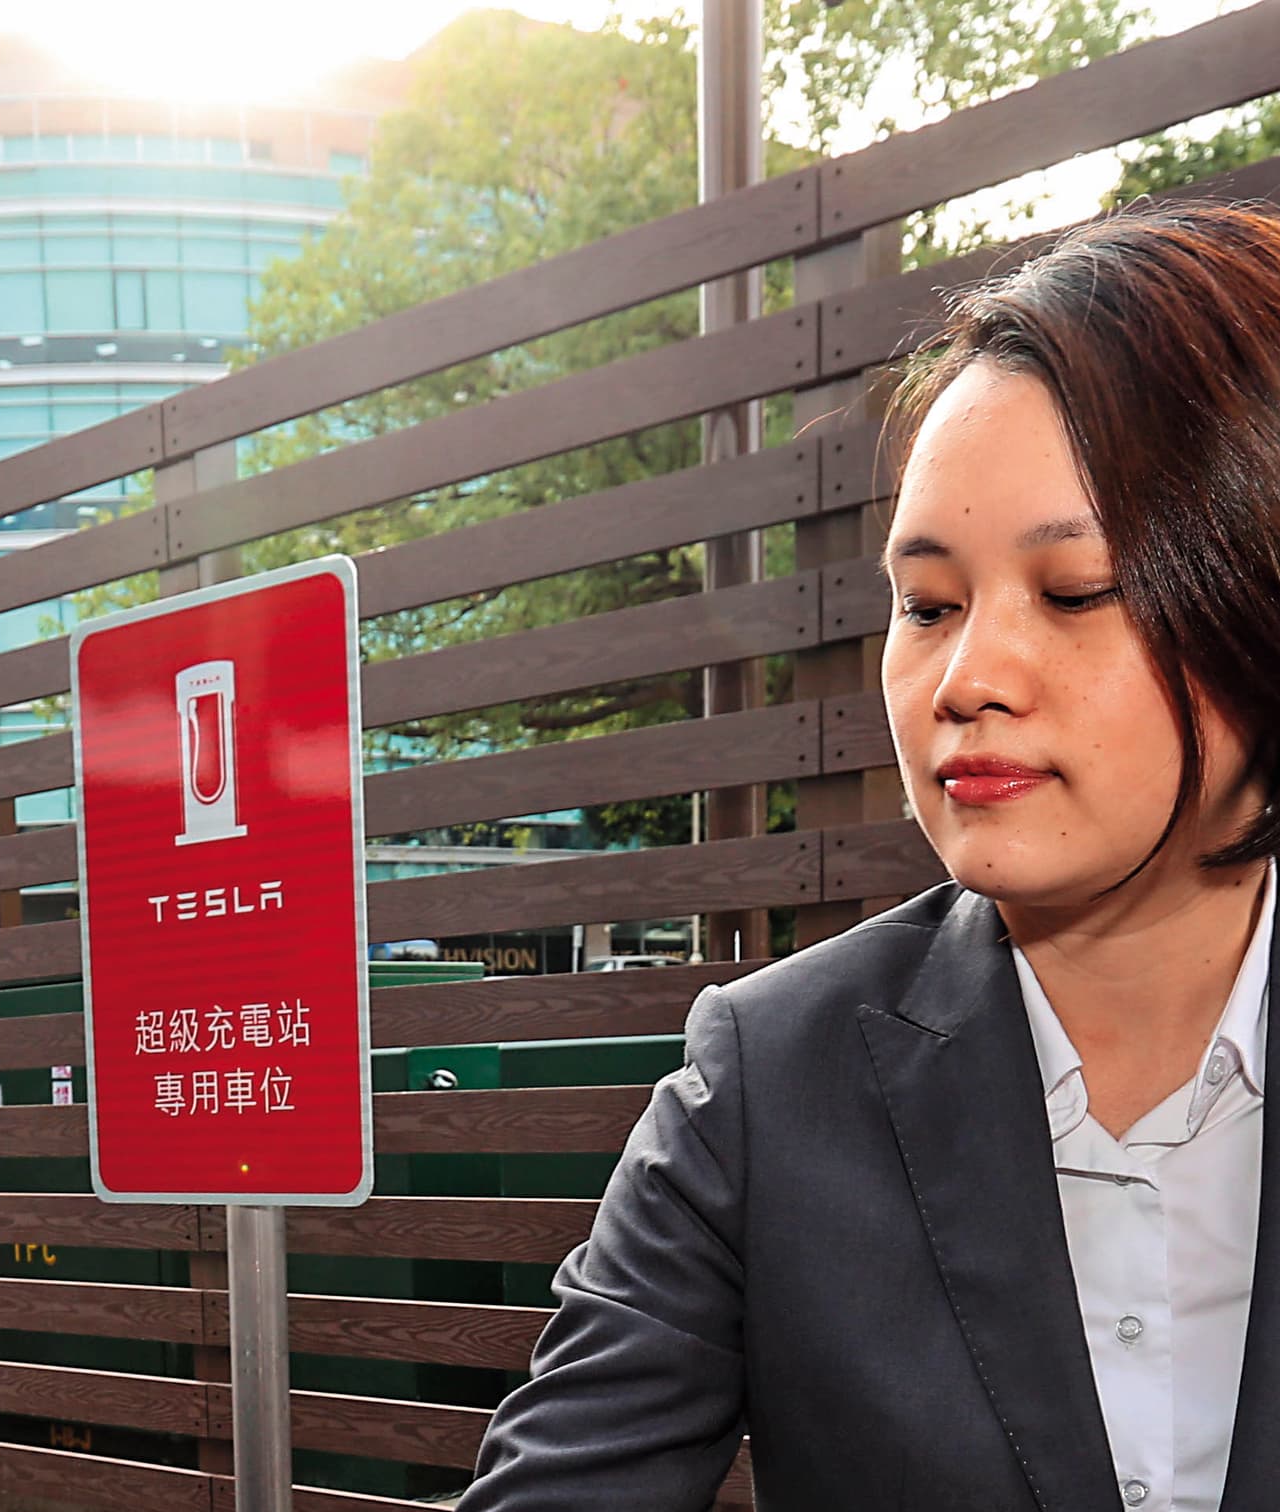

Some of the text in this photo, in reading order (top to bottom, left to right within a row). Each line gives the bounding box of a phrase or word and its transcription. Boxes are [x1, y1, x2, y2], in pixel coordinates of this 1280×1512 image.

[147, 880, 283, 923] TESLA
[134, 998, 311, 1056] 超級充電站
[153, 1065, 296, 1117] 專用車位
